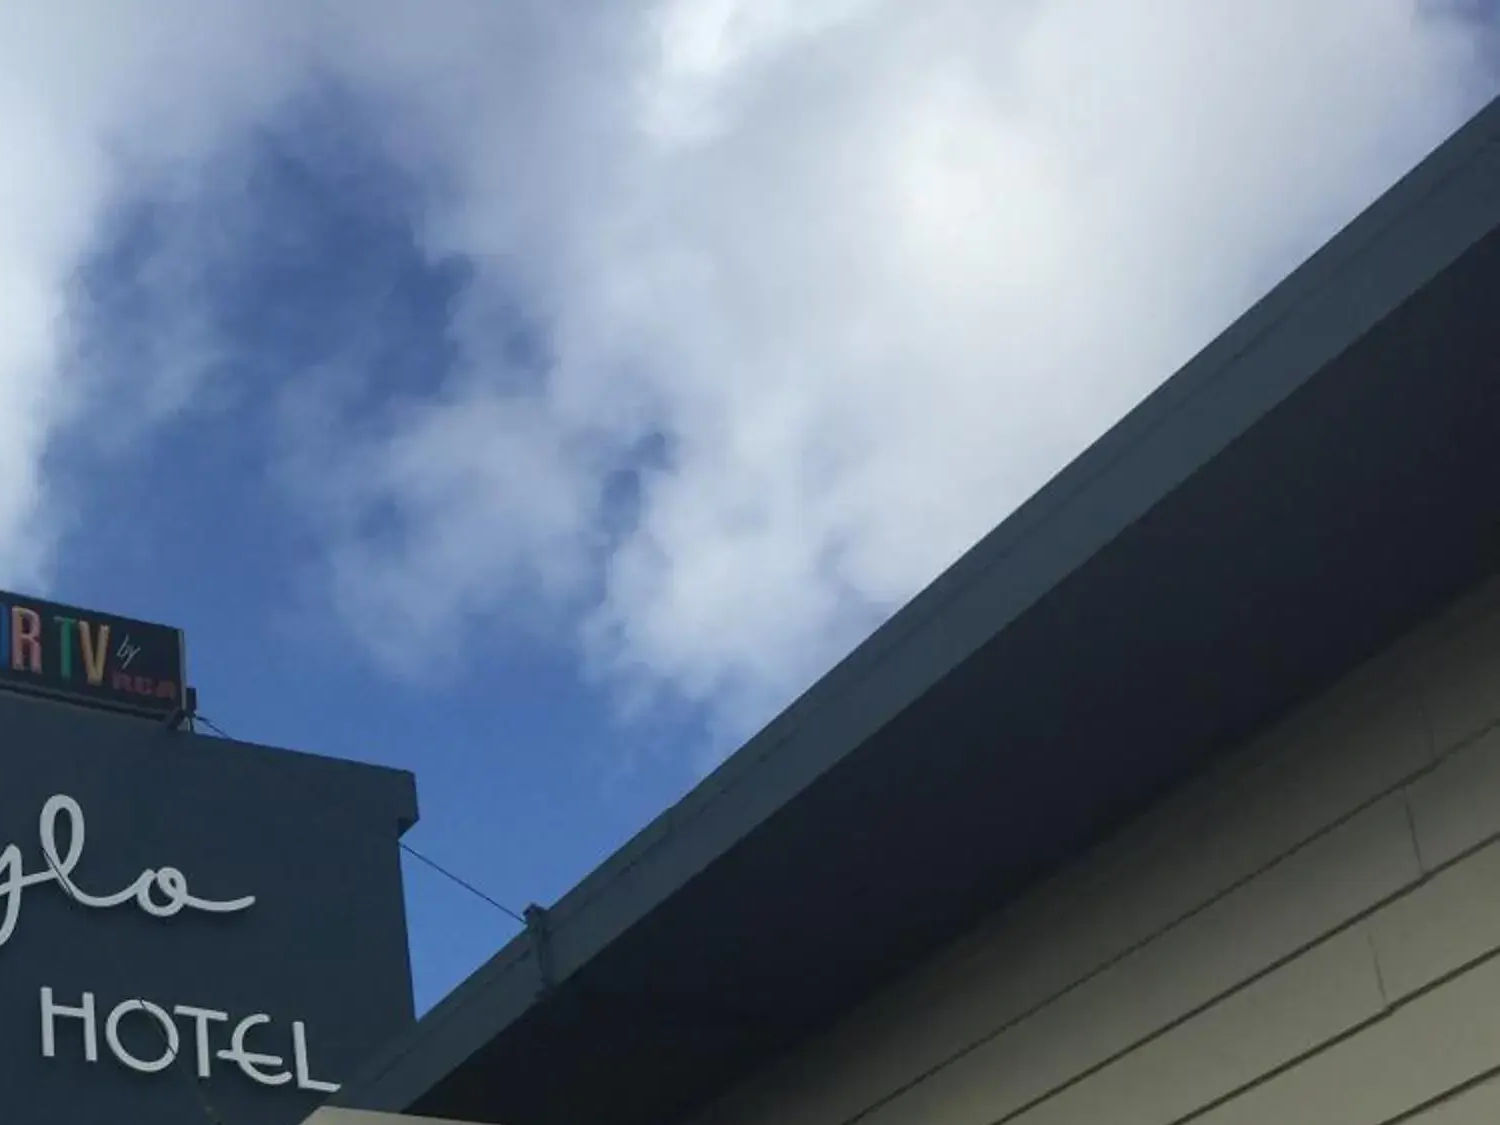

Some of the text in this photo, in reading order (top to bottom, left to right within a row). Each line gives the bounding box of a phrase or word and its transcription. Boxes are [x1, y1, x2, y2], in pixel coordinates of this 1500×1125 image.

[54, 616, 110, 686] TV
[116, 633, 142, 672] by
[112, 672, 178, 700] RCA
[40, 986, 341, 1092] HOTEL
